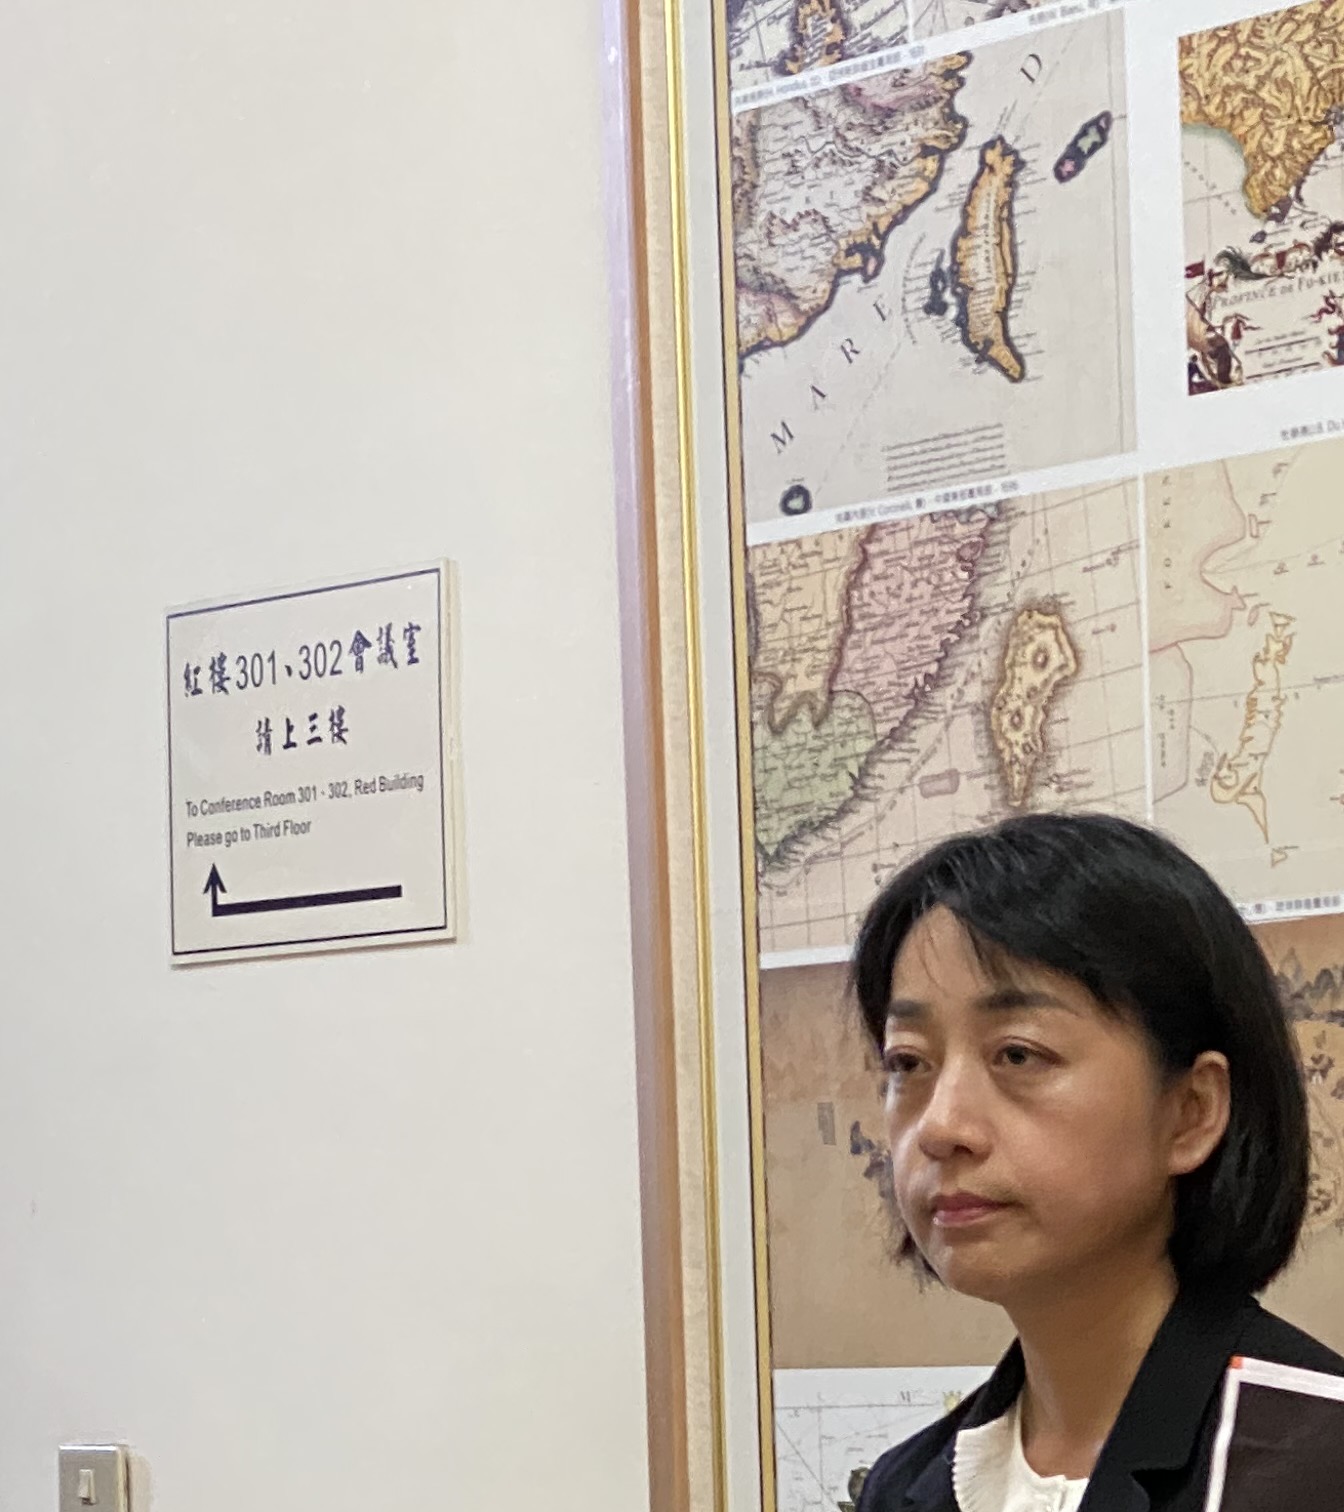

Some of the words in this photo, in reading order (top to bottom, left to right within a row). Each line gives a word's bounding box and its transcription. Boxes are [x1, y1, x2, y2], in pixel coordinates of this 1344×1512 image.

[256, 705, 349, 756] 請上三樓
[186, 800, 198, 818] To
[200, 795, 262, 816] Conference
[263, 790, 297, 808] Room
[354, 777, 376, 796] Red
[379, 772, 424, 794] Building
[187, 829, 222, 848] Please
[225, 830, 238, 848] go
[240, 827, 251, 842] to
[253, 822, 280, 840] Third
[283, 818, 312, 836] Floor
